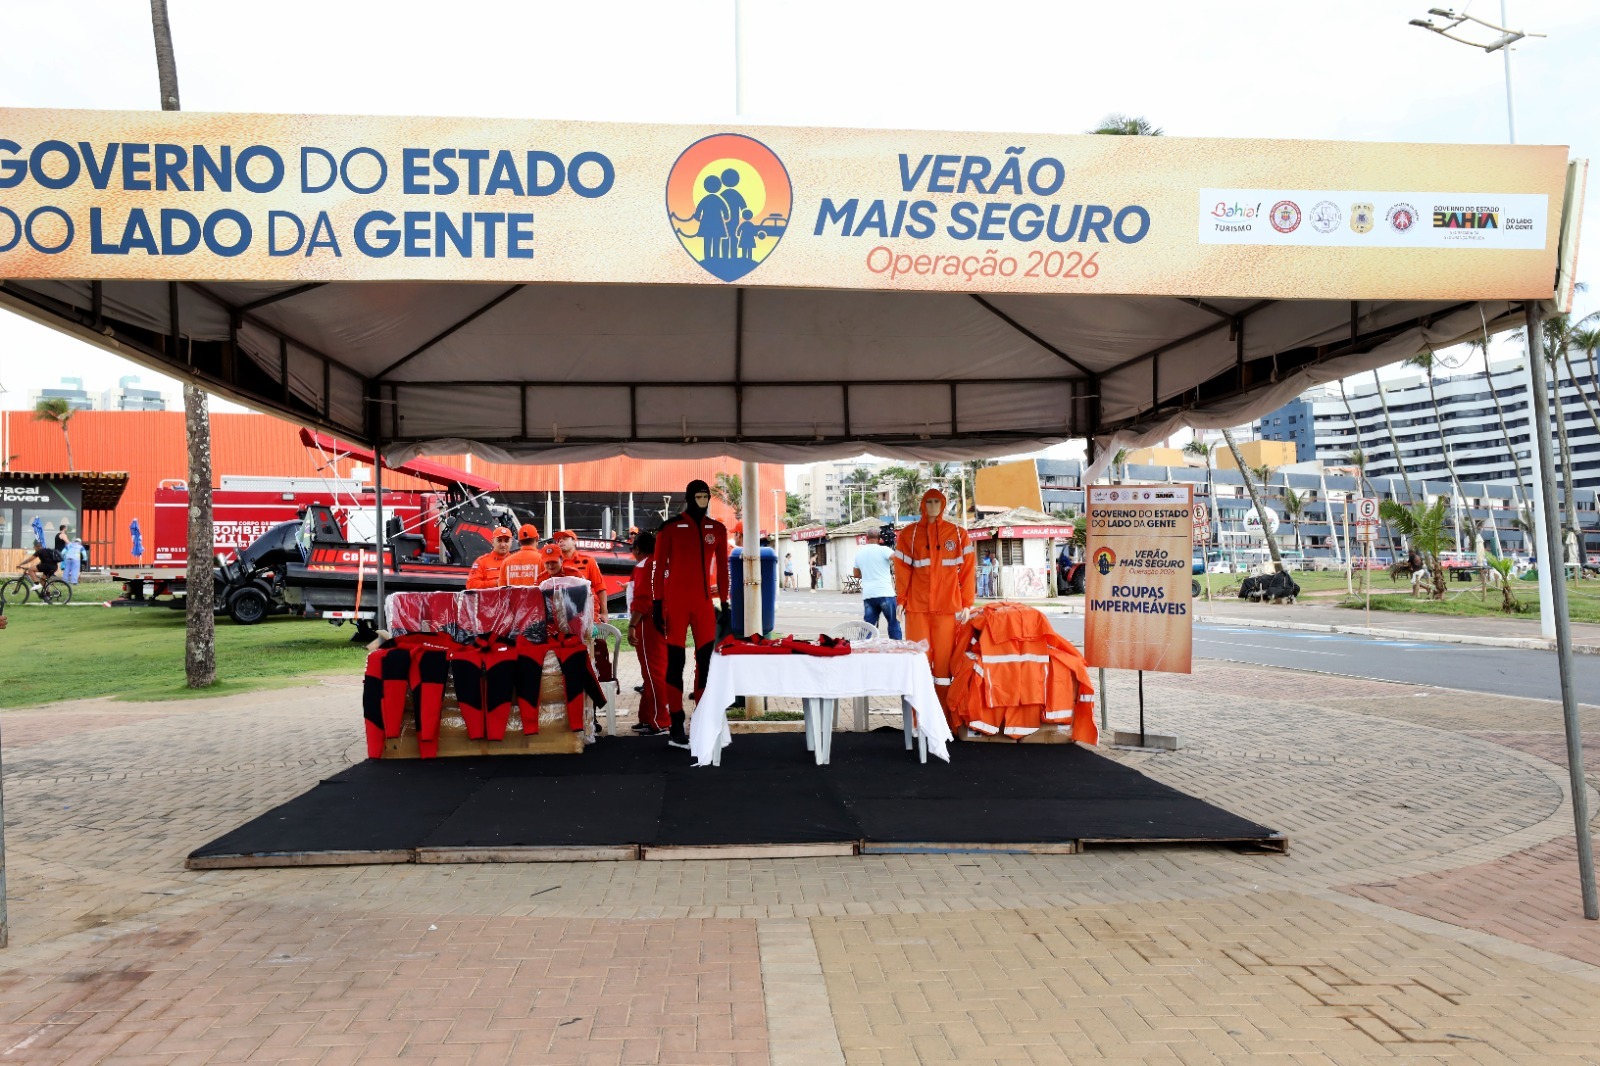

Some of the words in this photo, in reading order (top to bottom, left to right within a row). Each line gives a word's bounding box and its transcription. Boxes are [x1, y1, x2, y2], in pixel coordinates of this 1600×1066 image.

[0, 139, 285, 194] GOVERNO
[300, 146, 388, 194] DO
[402, 148, 615, 198] ESTADO
[898, 146, 1066, 196] VERÃO
[813, 197, 937, 240] MAIS
[946, 202, 1151, 244] SEGURO
[1433, 212, 1498, 229] BAHIA
[90, 207, 252, 257] LADO
[268, 210, 342, 257] DA
[354, 209, 534, 259] GENTE
[1214, 224, 1252, 232] TURISMO
[865, 245, 1018, 282] Operação
[1023, 249, 1100, 278] 2026
[4, 494, 50, 502] lovers
[1092, 509, 1137, 518] GOVERNO
[1138, 509, 1153, 518] DO
[1154, 509, 1189, 518] ESTADO
[1365, 503, 1371, 514] E
[1091, 520, 1106, 528] DO
[1107, 520, 1132, 528] LADO
[1133, 520, 1145, 528] DA
[1146, 520, 1176, 528] GENTE
[1022, 527, 1049, 535] ACARAJÉ
[213, 534, 260, 543] MILI
[342, 552, 386, 563] CBMB
[1135, 548, 1168, 559] VERÃO
[1119, 559, 1143, 567] MAIS
[1145, 560, 1185, 568] SEGURO
[1111, 585, 1165, 599] ROUPAS
[1090, 599, 1186, 615] IMPERMEÁVEIS
